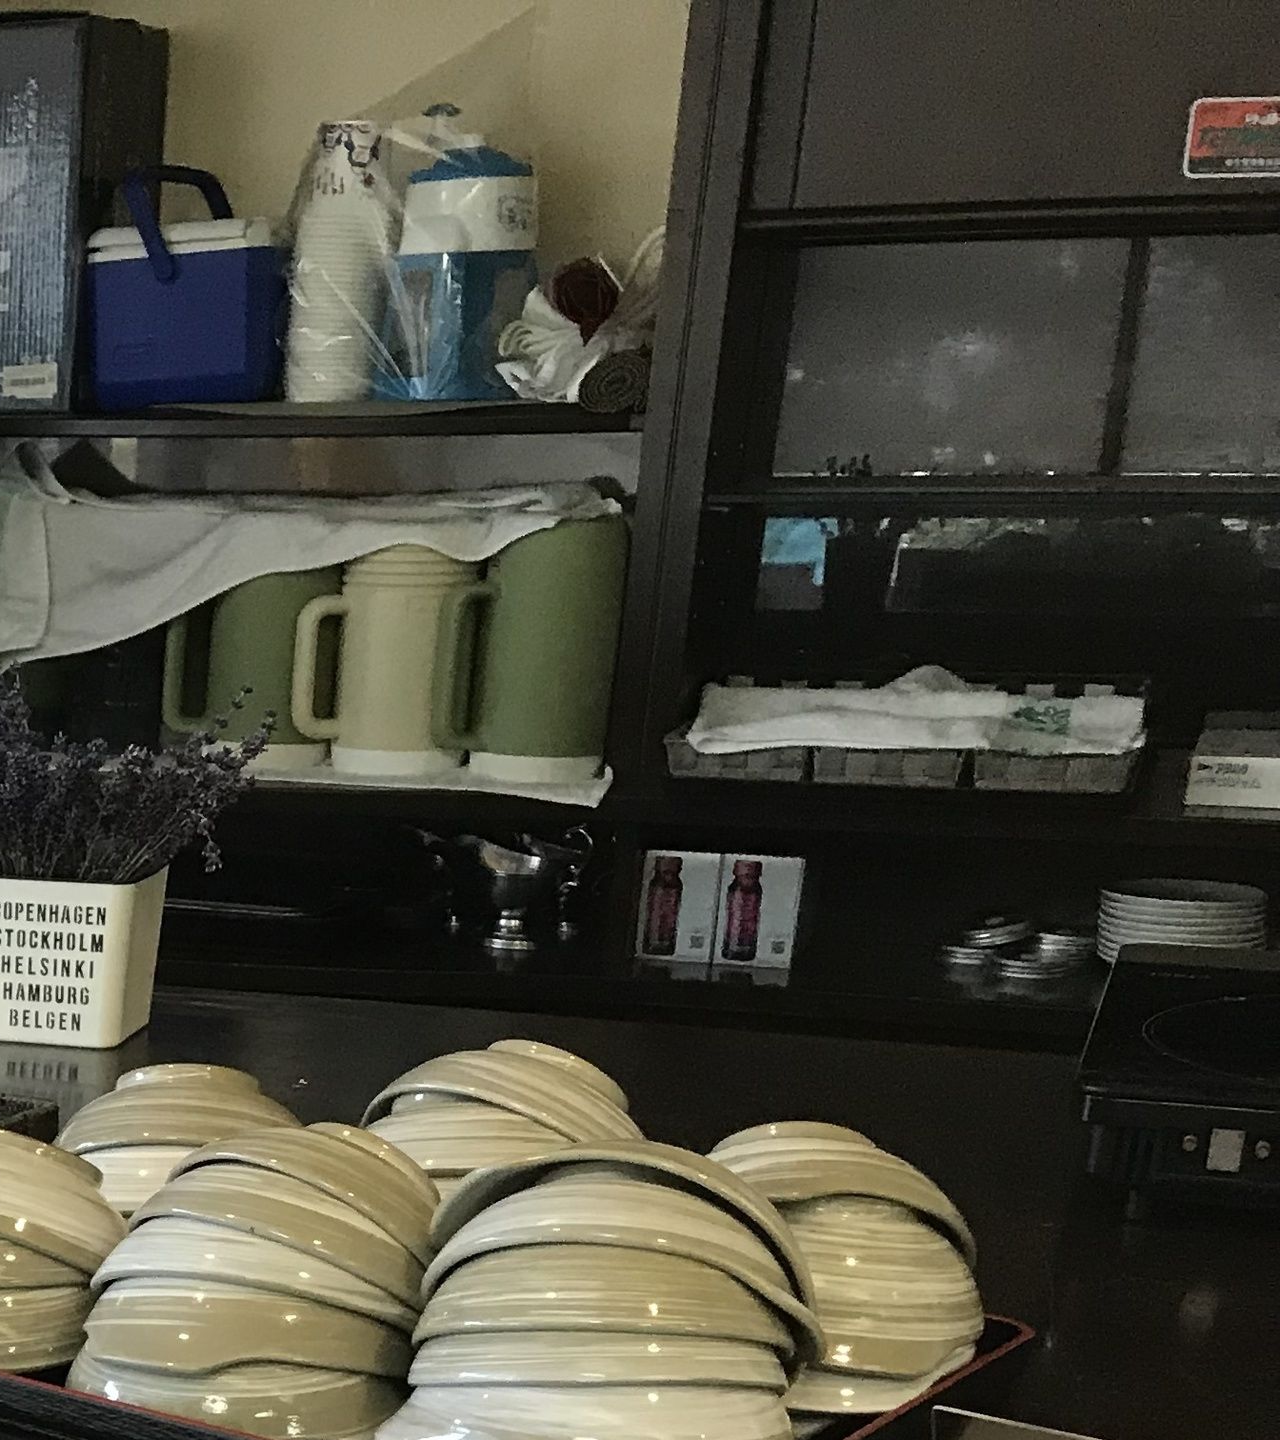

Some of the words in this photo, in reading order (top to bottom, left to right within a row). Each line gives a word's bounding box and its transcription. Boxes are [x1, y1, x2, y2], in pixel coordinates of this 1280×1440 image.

[1, 955, 94, 978] HELSINKI
[3, 982, 90, 1005] HAMBURG
[9, 1009, 82, 1032] BELGEN
